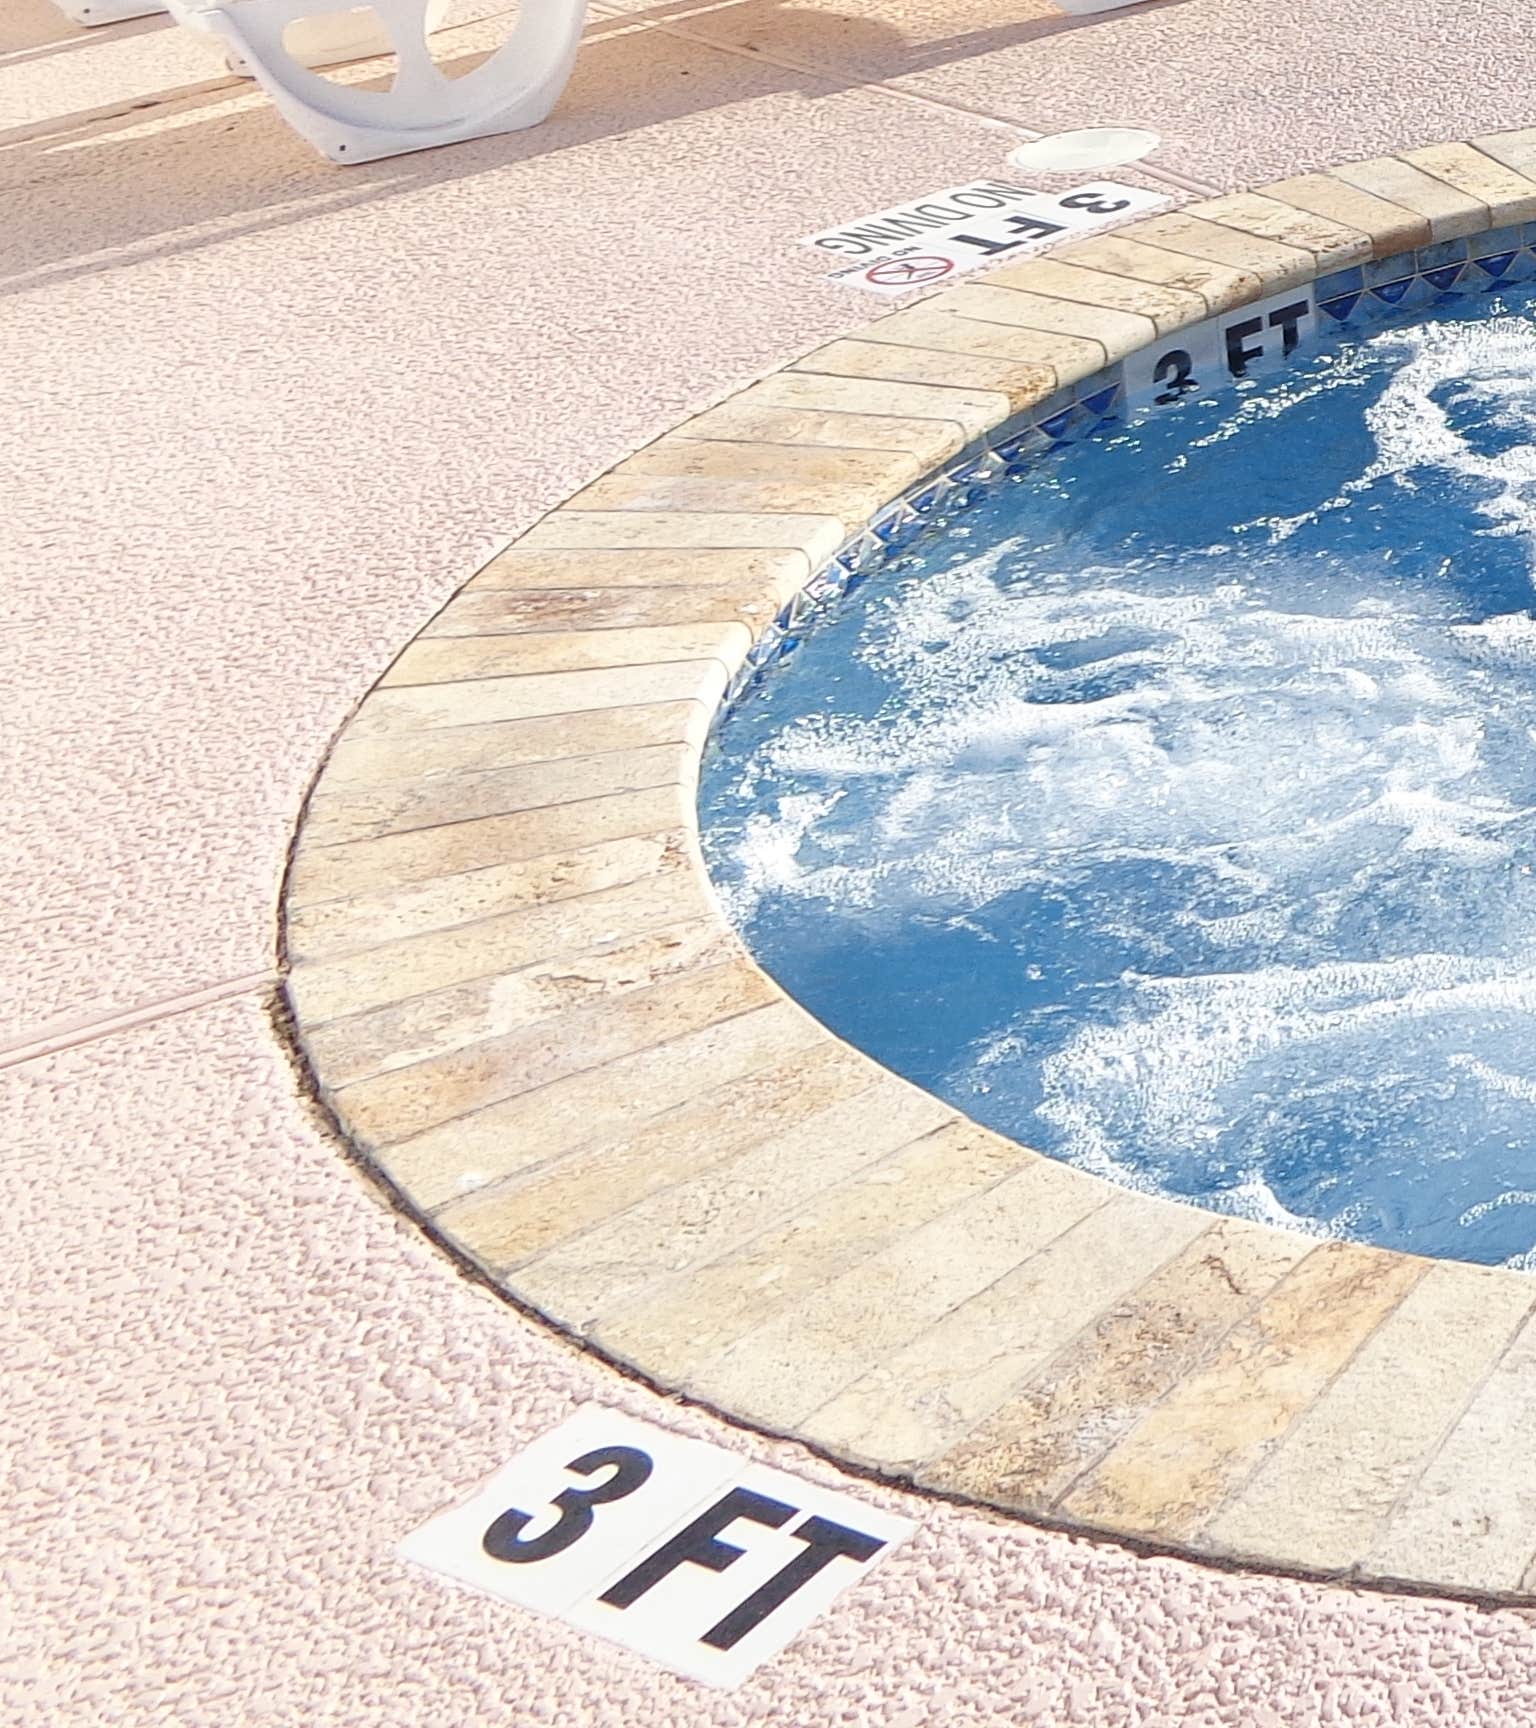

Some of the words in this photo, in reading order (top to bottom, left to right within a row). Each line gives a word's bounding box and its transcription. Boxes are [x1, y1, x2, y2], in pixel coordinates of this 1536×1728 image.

[950, 182, 1037, 209] NO
[1058, 191, 1132, 215] 3
[814, 203, 976, 255] DIVING
[948, 215, 1068, 257] FT
[827, 254, 890, 280] DIVING
[892, 245, 923, 257] NO
[1225, 298, 1310, 378] FT
[482, 1445, 655, 1565] 3
[597, 1486, 889, 1652] FT
